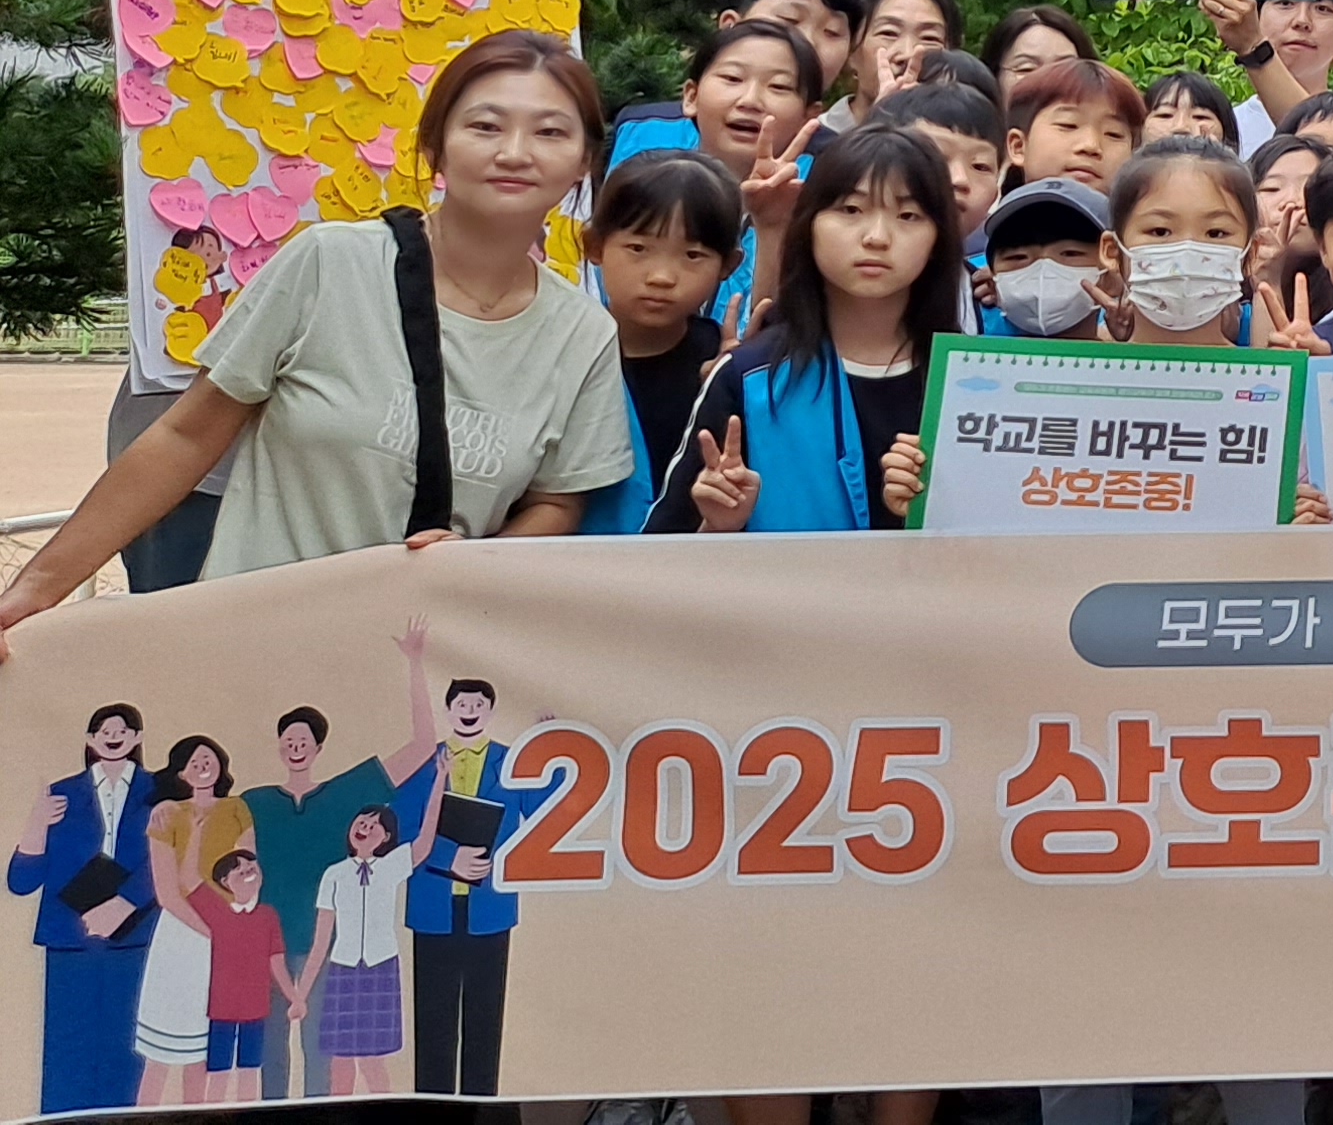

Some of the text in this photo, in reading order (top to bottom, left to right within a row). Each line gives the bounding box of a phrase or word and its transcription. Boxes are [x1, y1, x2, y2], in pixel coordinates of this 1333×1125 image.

[955, 411, 1269, 465] 학교를 바꾸는 힘!
[1021, 465, 1195, 512] 상호존중!
[1156, 597, 1321, 650] 모두가
[504, 726, 945, 882] 2025
